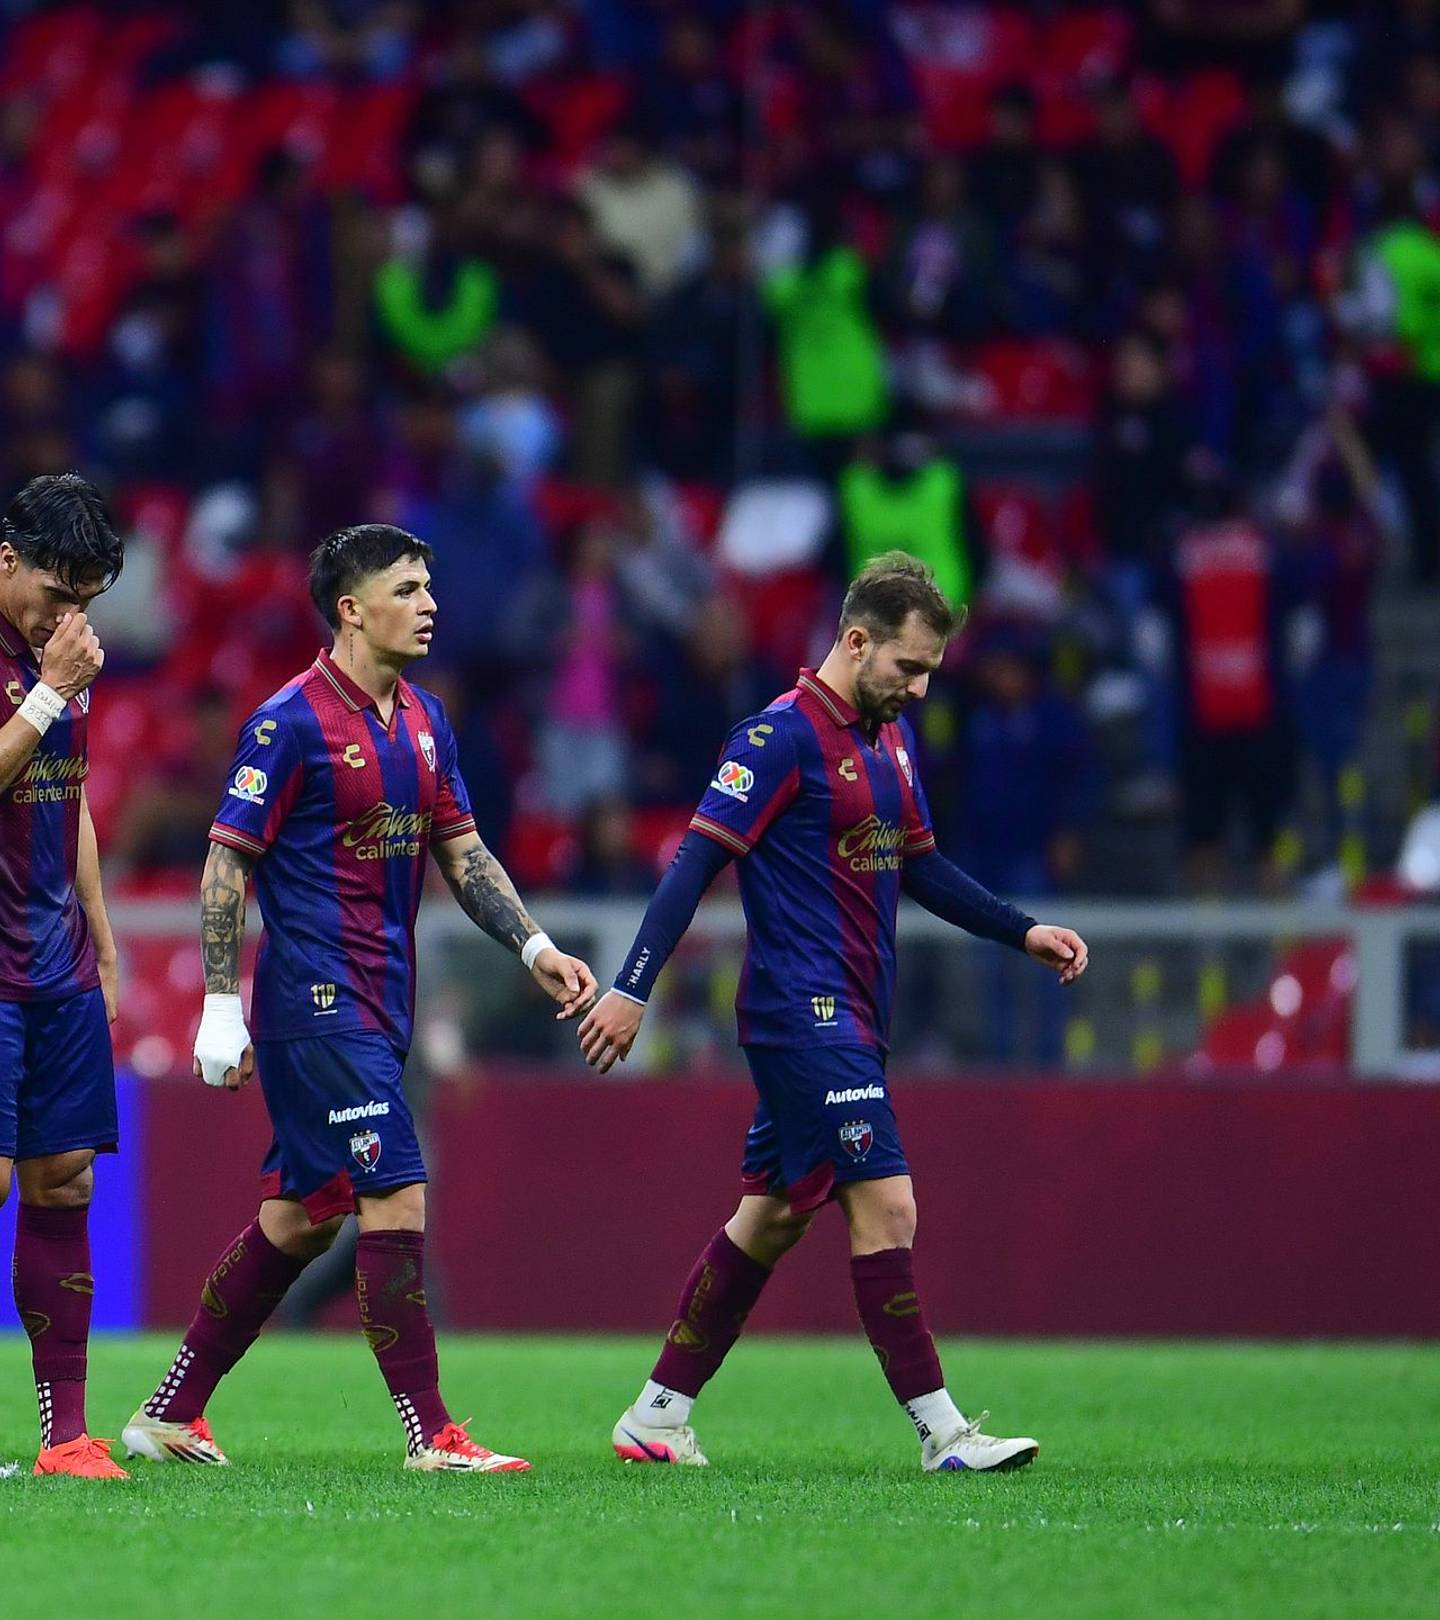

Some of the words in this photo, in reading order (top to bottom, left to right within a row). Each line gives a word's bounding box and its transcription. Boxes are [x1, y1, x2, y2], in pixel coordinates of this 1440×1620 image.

[12, 784, 80, 803] caliente.m
[626, 946, 651, 989] HARLY
[310, 983, 337, 1009] 110
[810, 996, 836, 1022] 110
[824, 1083, 885, 1106] Autovías
[328, 1099, 391, 1125] Autovías
